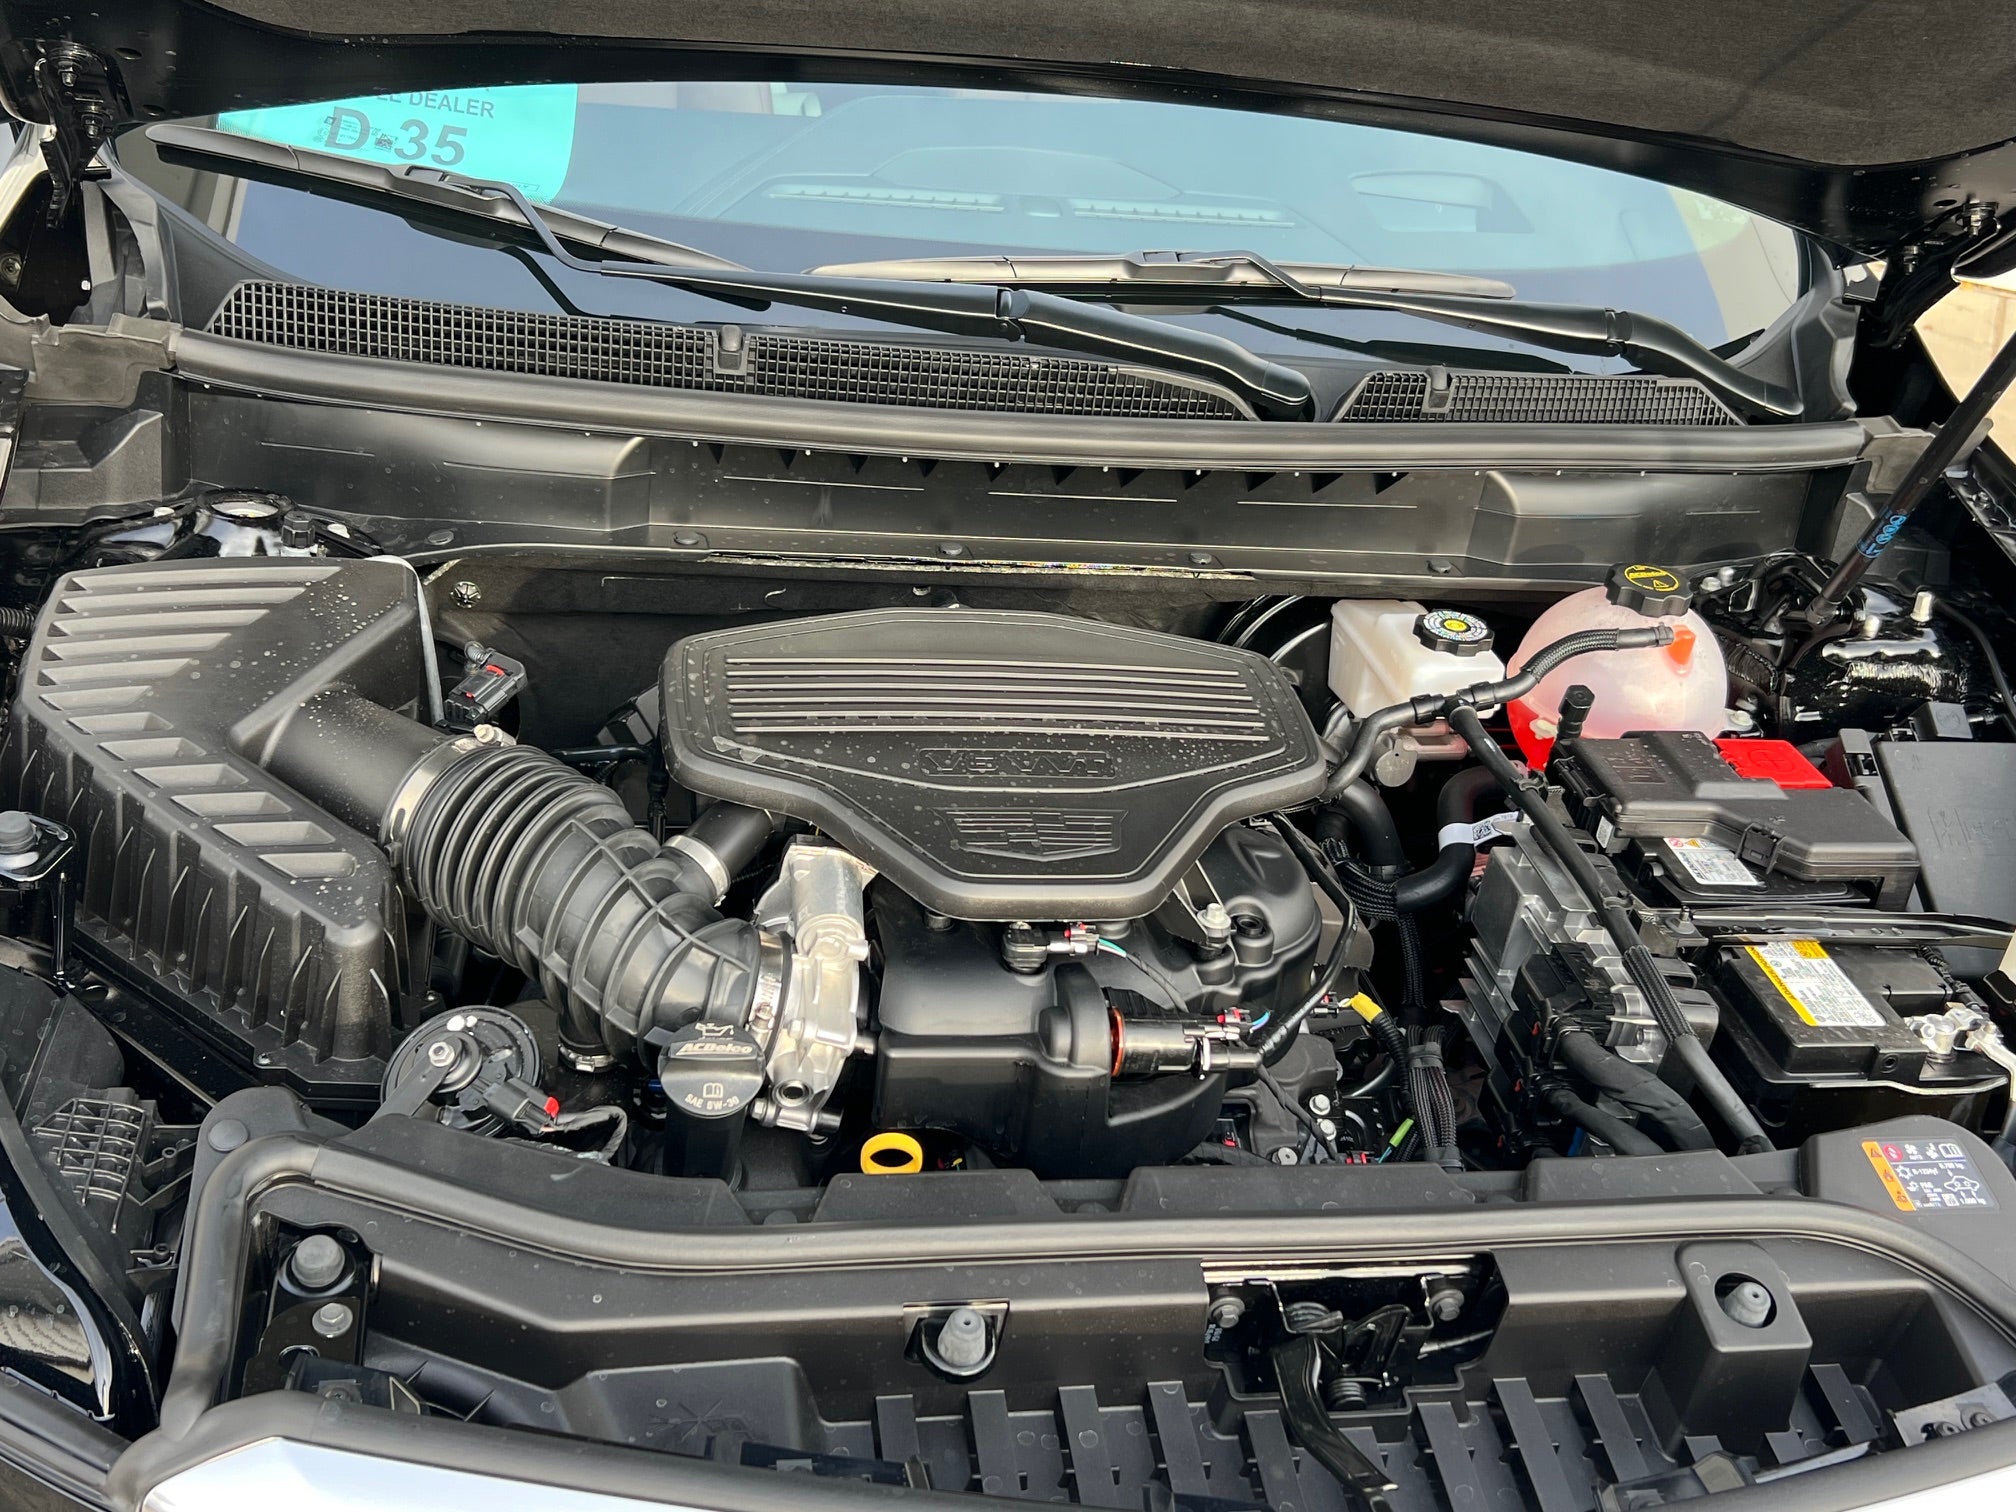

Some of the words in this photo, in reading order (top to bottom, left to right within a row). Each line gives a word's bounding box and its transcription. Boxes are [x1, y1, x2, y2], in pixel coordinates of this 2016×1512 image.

[409, 92, 494, 119] DEALER
[676, 1042, 753, 1056] ACDelco
[685, 1094, 704, 1109] SAE
